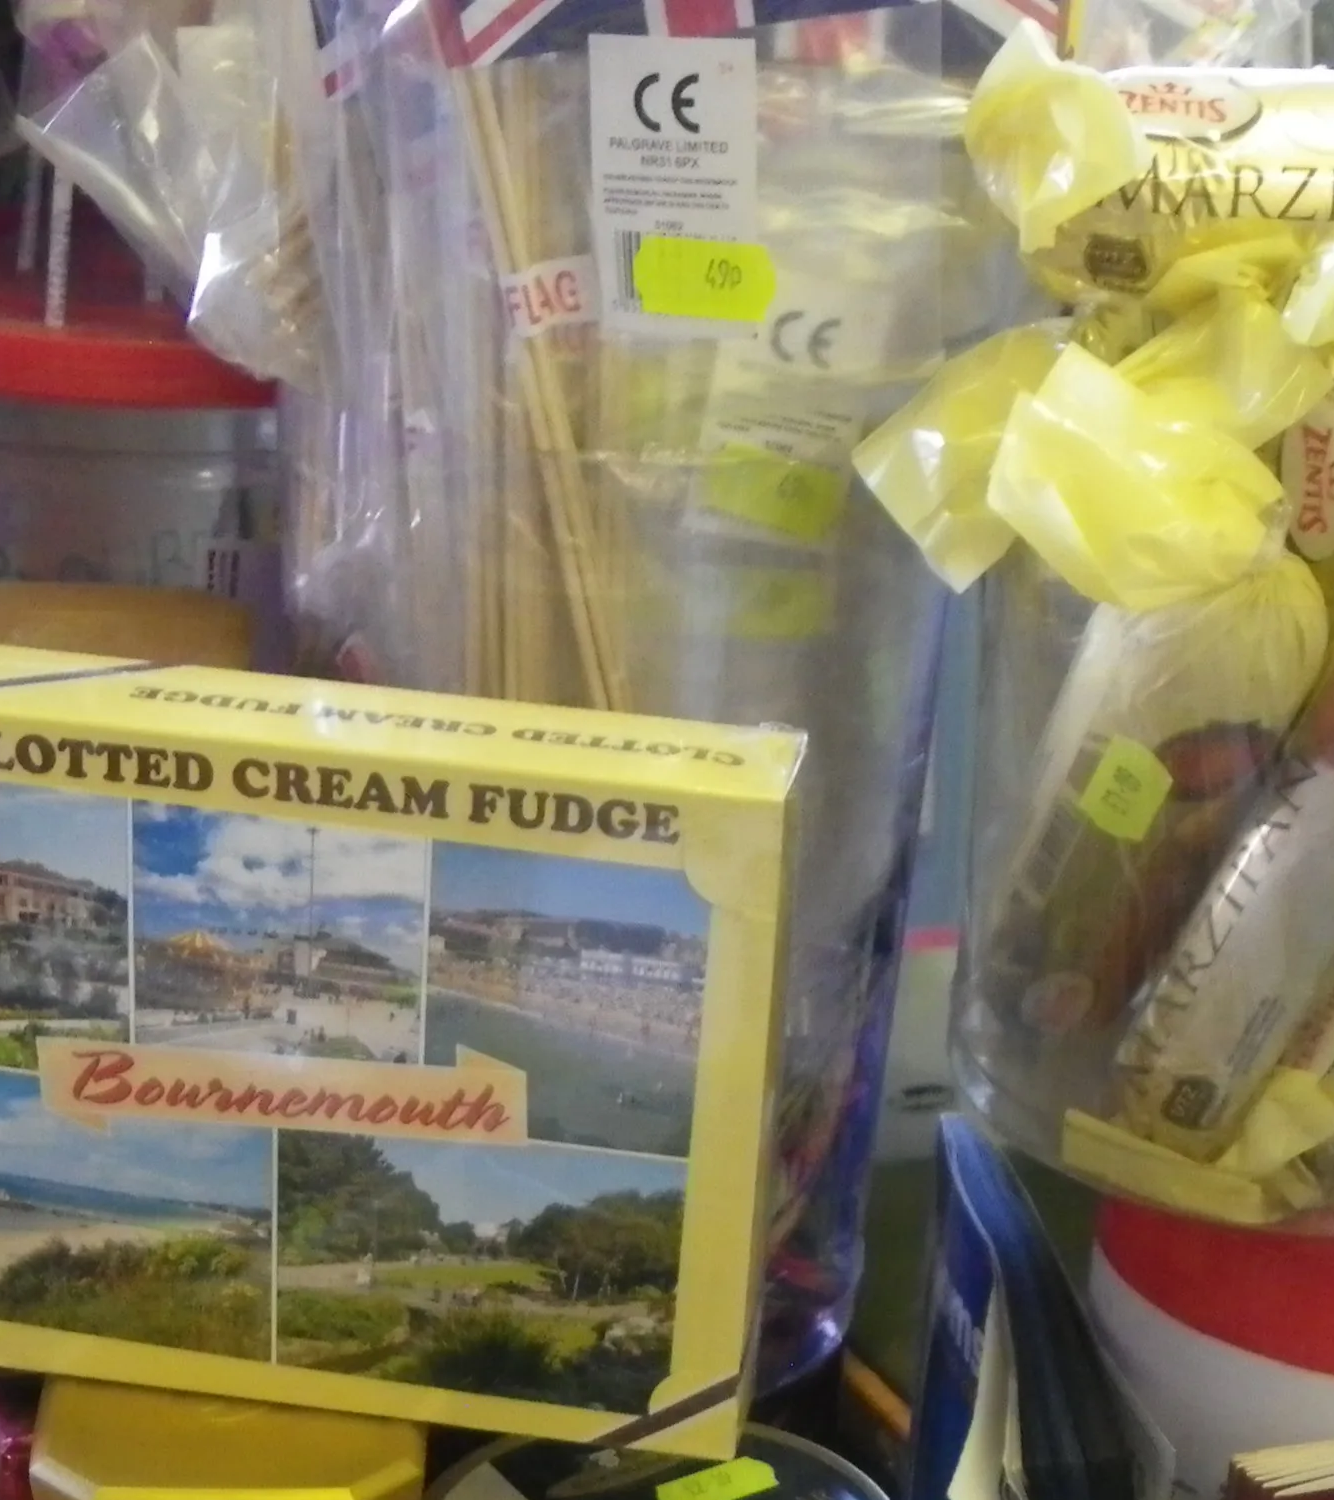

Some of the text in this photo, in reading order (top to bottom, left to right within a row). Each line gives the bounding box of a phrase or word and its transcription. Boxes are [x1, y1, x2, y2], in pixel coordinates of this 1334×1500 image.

[1119, 90, 1228, 123] ZENTIS
[675, 140, 729, 154] LIMITED
[507, 269, 582, 327] FLAG
[704, 258, 743, 290] 49p
[1299, 423, 1334, 535] ZENTIS
[130, 684, 745, 767] CLOTTED CREAM FUDGE
[231, 757, 450, 820] CREAM
[468, 783, 681, 845] FUDGE
[72, 1049, 510, 1135] Bournemouth
